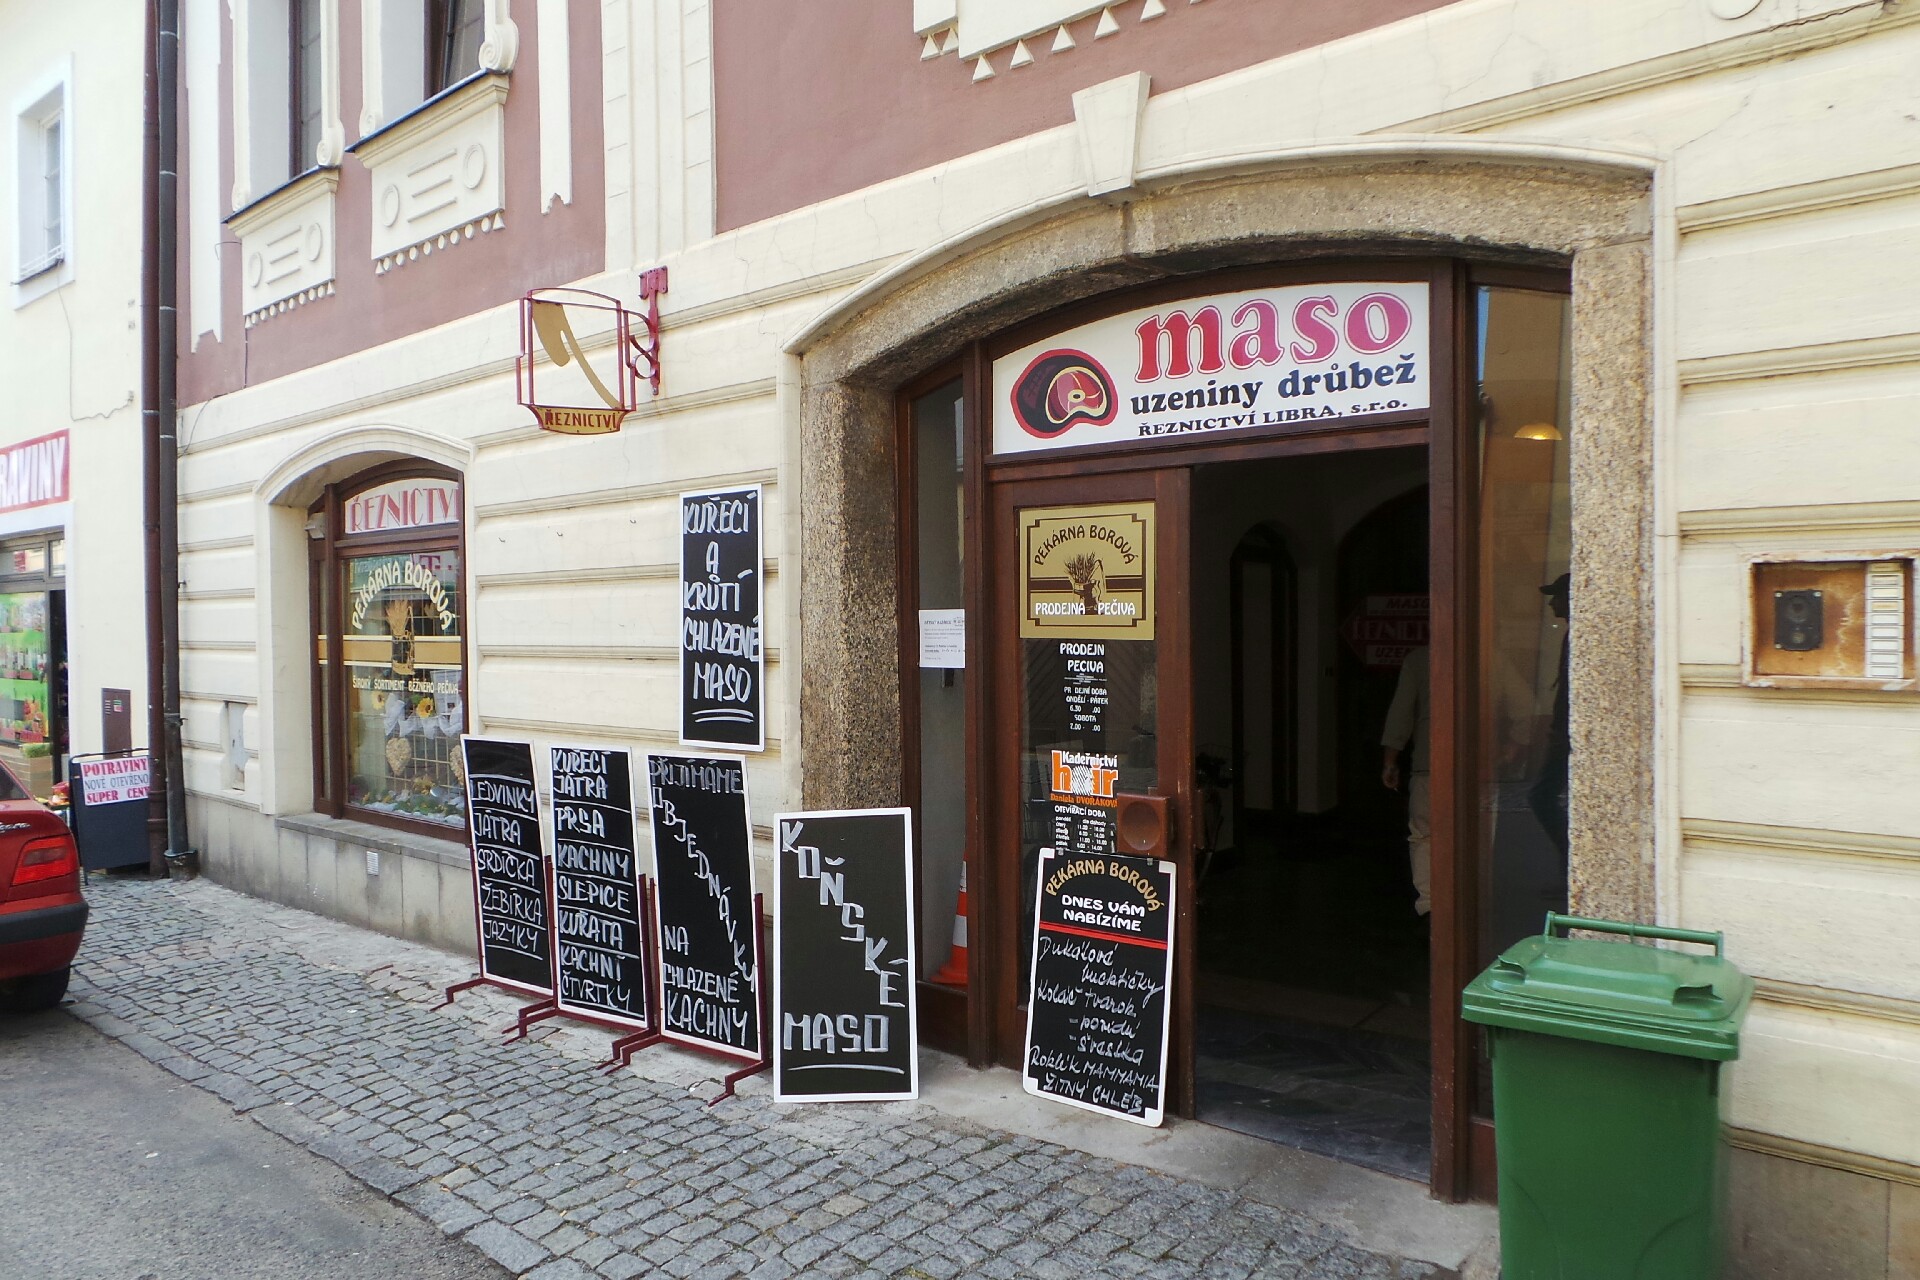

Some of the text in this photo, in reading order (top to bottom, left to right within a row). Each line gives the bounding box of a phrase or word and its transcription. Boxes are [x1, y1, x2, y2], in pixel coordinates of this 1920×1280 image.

[1134, 292, 1412, 384] maso
[1130, 352, 1417, 417] uzeniny drůbež
[544, 409, 617, 429] ŘEZNICTVÍ
[1138, 399, 1409, 437] ŘEZNICTVÍ LIBRA, s.r.o.
[705, 540, 720, 575] A
[1033, 524, 1139, 566] PEKÁRNA BOROVÁ
[351, 559, 456, 631] PEKÁRNA BOROVÁ
[1035, 599, 1136, 616] PRODEJNA PEČIVA
[1059, 642, 1105, 656] PRODEJN
[373, 678, 405, 692] SORTIMENT
[407, 678, 435, 694] BĚŽNÉHO
[692, 661, 752, 703] MASO
[82, 758, 148, 777] POTRAVINY
[1062, 750, 1118, 768] Kadeřnictví
[86, 790, 119, 804] SUPER
[1087, 809, 1107, 819] DOBA
[554, 805, 606, 839] PRSA
[557, 842, 629, 879] KACHNY
[557, 875, 632, 914] SLEPICE
[1045, 859, 1166, 912] PEKÁRNA BOROVÁ
[1061, 894, 1146, 918] DNES VÁM
[1063, 909, 1142, 932] NABÍZÍME
[483, 919, 539, 953] JAZYKY
[664, 924, 690, 956] NA
[561, 970, 632, 1012] ČTVRTKY
[662, 962, 741, 1004] CHLAZENÉ
[667, 989, 748, 1047] KACHNY
[783, 1011, 890, 1055] MASO
